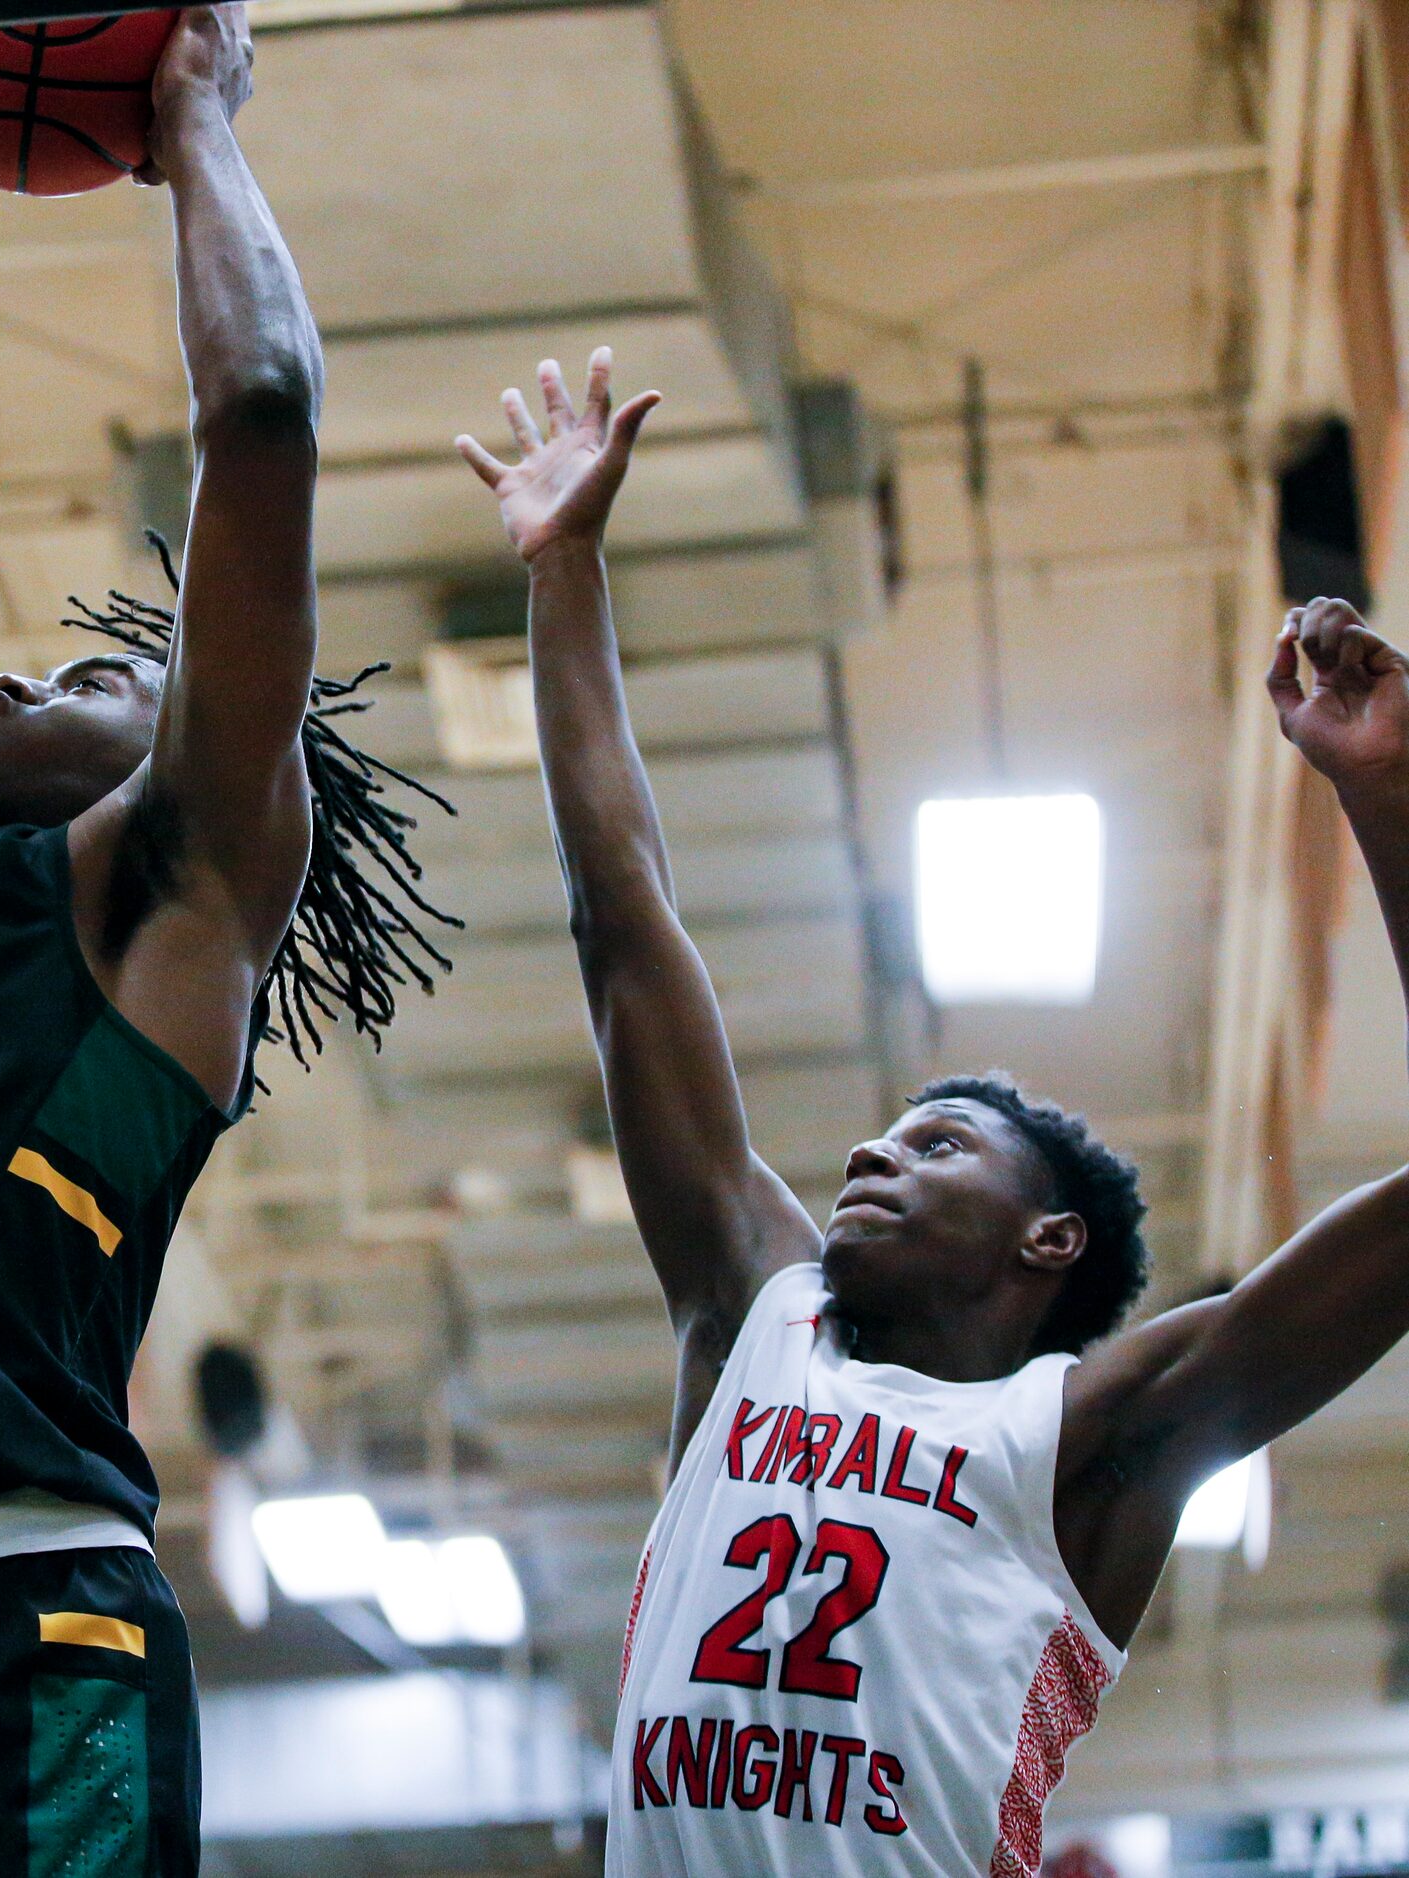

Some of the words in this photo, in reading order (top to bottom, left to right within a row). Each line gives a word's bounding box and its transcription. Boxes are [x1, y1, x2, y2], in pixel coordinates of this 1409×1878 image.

[721, 1397, 978, 1528] KIMBALL
[689, 1513, 891, 1703] 22
[633, 1715, 908, 1837] KNIGHTS
